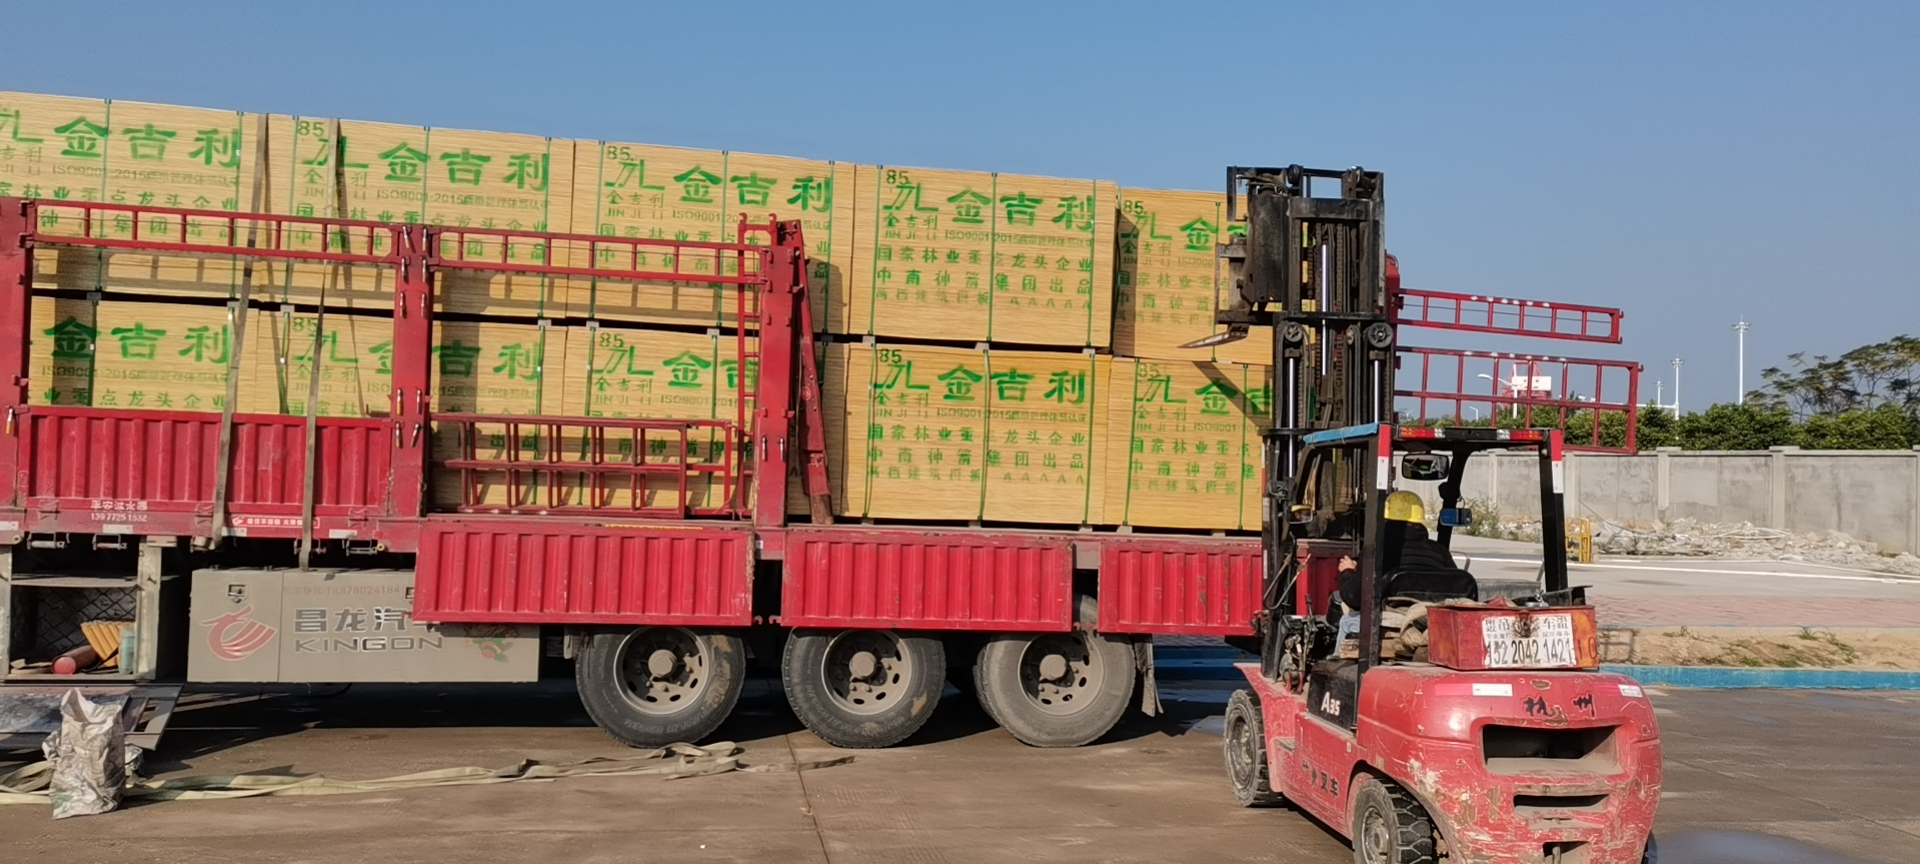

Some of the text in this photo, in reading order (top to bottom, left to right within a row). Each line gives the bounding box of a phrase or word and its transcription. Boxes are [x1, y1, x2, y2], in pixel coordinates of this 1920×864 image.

[298, 121, 325, 136] 85
[54, 116, 240, 168] 金吉利
[378, 141, 549, 192] 金吉利
[887, 170, 909, 184] 85
[673, 165, 832, 213] 金吉利
[606, 190, 665, 209] 金吉利
[605, 207, 625, 218] JIN
[947, 188, 1094, 231] 金吉利
[883, 212, 938, 230] 金吉利
[1122, 240, 1171, 256] 金吉利
[44, 315, 230, 364] 金吉利
[599, 333, 624, 348] 85
[880, 349, 902, 363] 85
[594, 377, 653, 394] 金吉利
[937, 364, 1086, 405] 金吉利
[875, 391, 929, 407] 金吉利
[1136, 405, 1187, 421] 金吉利
[295, 607, 426, 632] 昌龙汽
[295, 636, 443, 652] KINGON
[1511, 639, 1540, 664] 2042
[1321, 692, 1341, 716] A35
